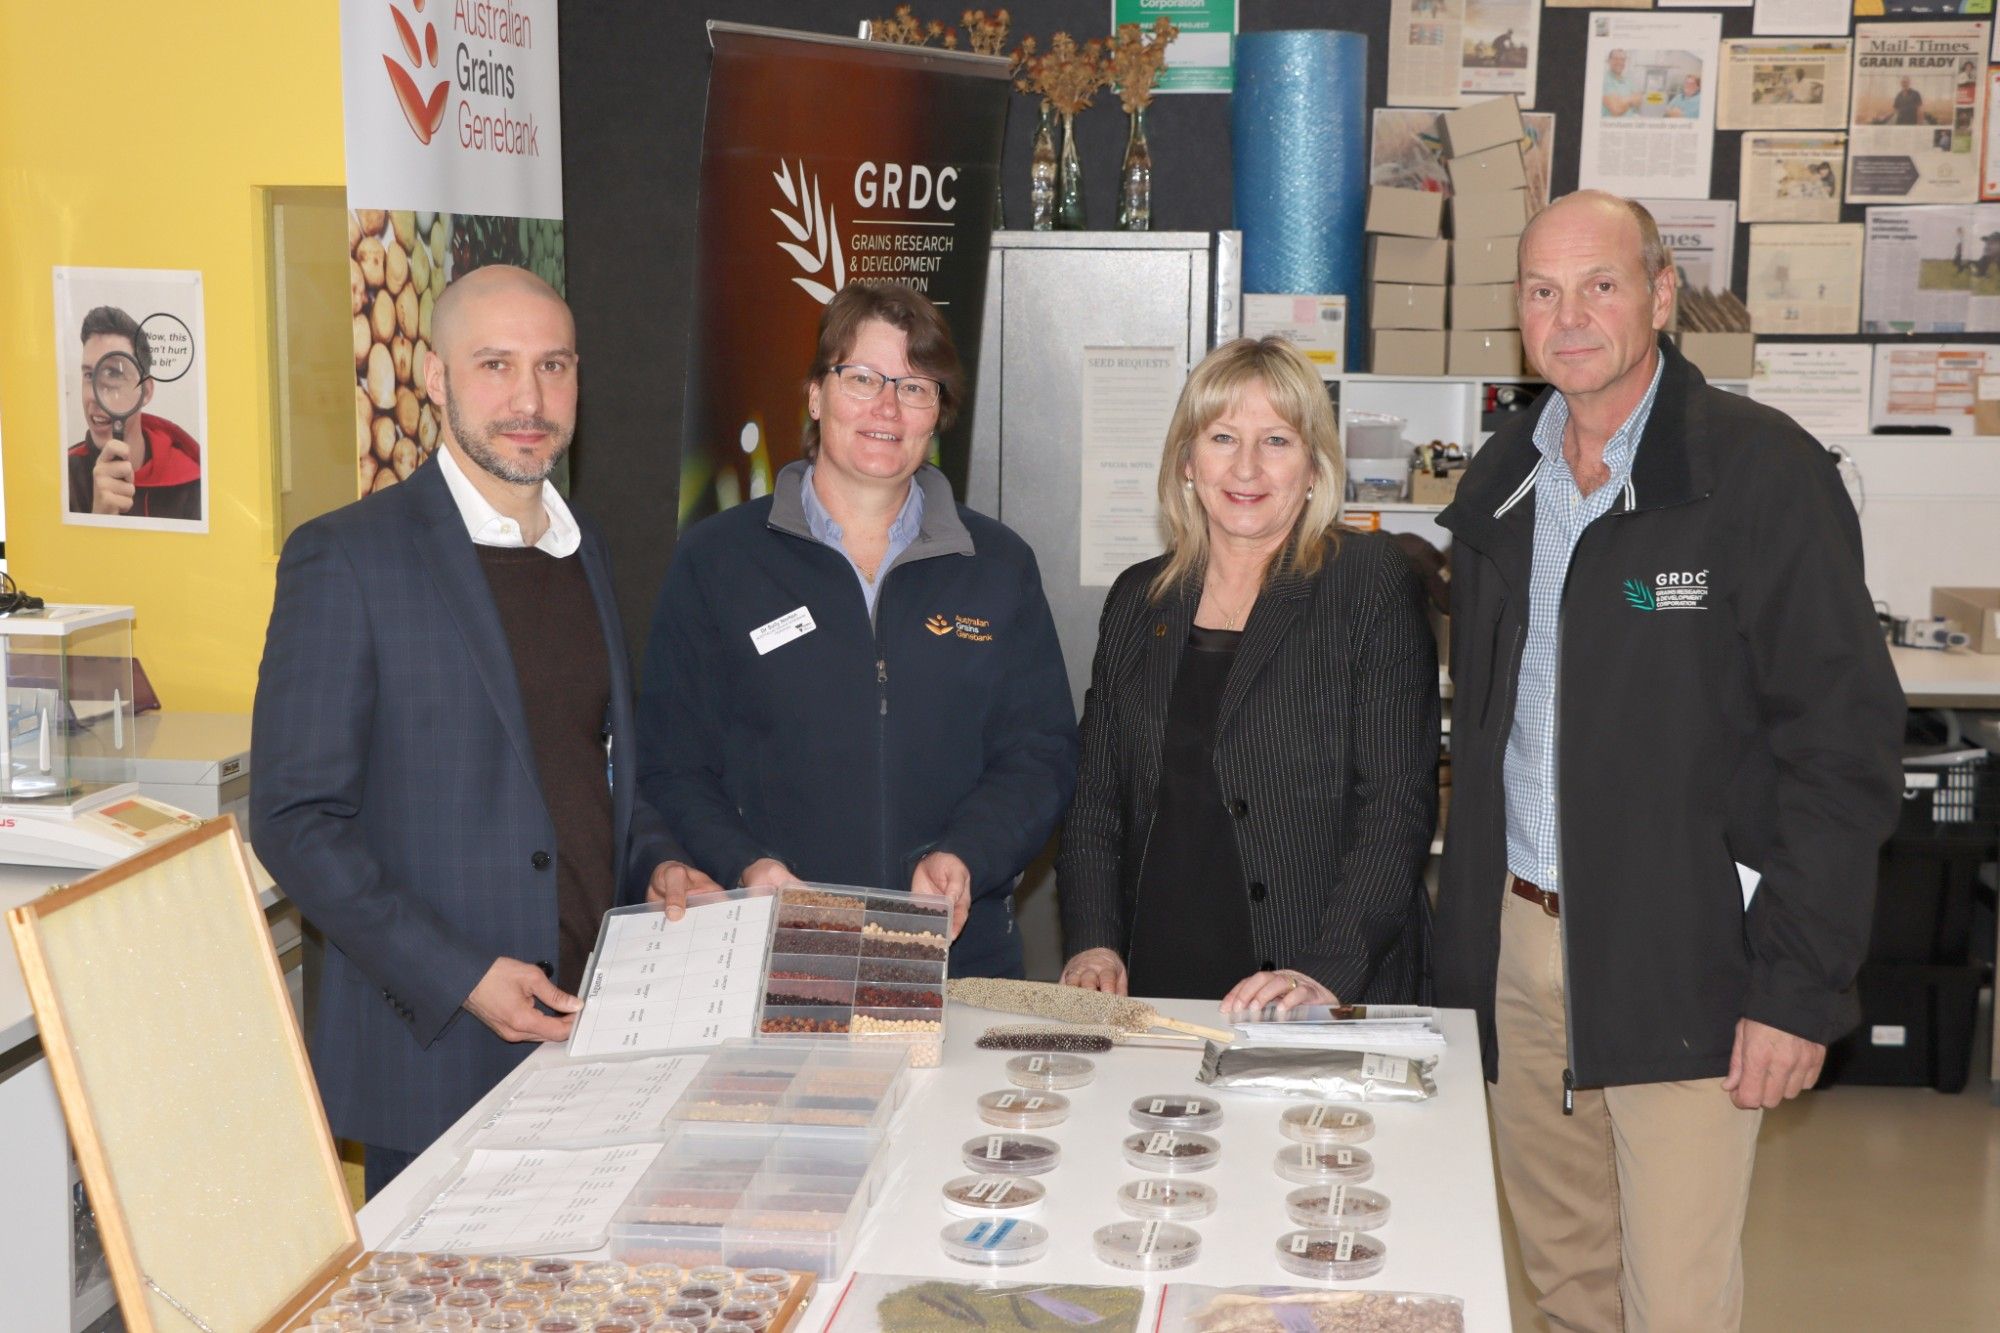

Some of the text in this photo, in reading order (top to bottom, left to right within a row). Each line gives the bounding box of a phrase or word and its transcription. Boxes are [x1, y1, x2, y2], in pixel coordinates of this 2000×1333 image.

[1140, 0, 1205, 10] Corporation
[454, 0, 532, 49] Australian
[1870, 40, 1971, 53] Mail-Times
[1859, 56, 1956, 68] GRAIN READY
[456, 42, 515, 99] Grains
[458, 100, 539, 156] Genebank
[854, 161, 959, 211] GRDC
[851, 234, 954, 251] GRAINS RESEARCH
[850, 256, 942, 272] & DEVELOPMENT
[169, 332, 187, 341] this
[167, 346, 187, 354] hurt
[1088, 358, 1171, 370] SEED REQUESTS
[1656, 572, 1707, 586] GRDC
[955, 615, 990, 628] Australian
[956, 622, 980, 634] Grains
[956, 630, 993, 642] Genebank
